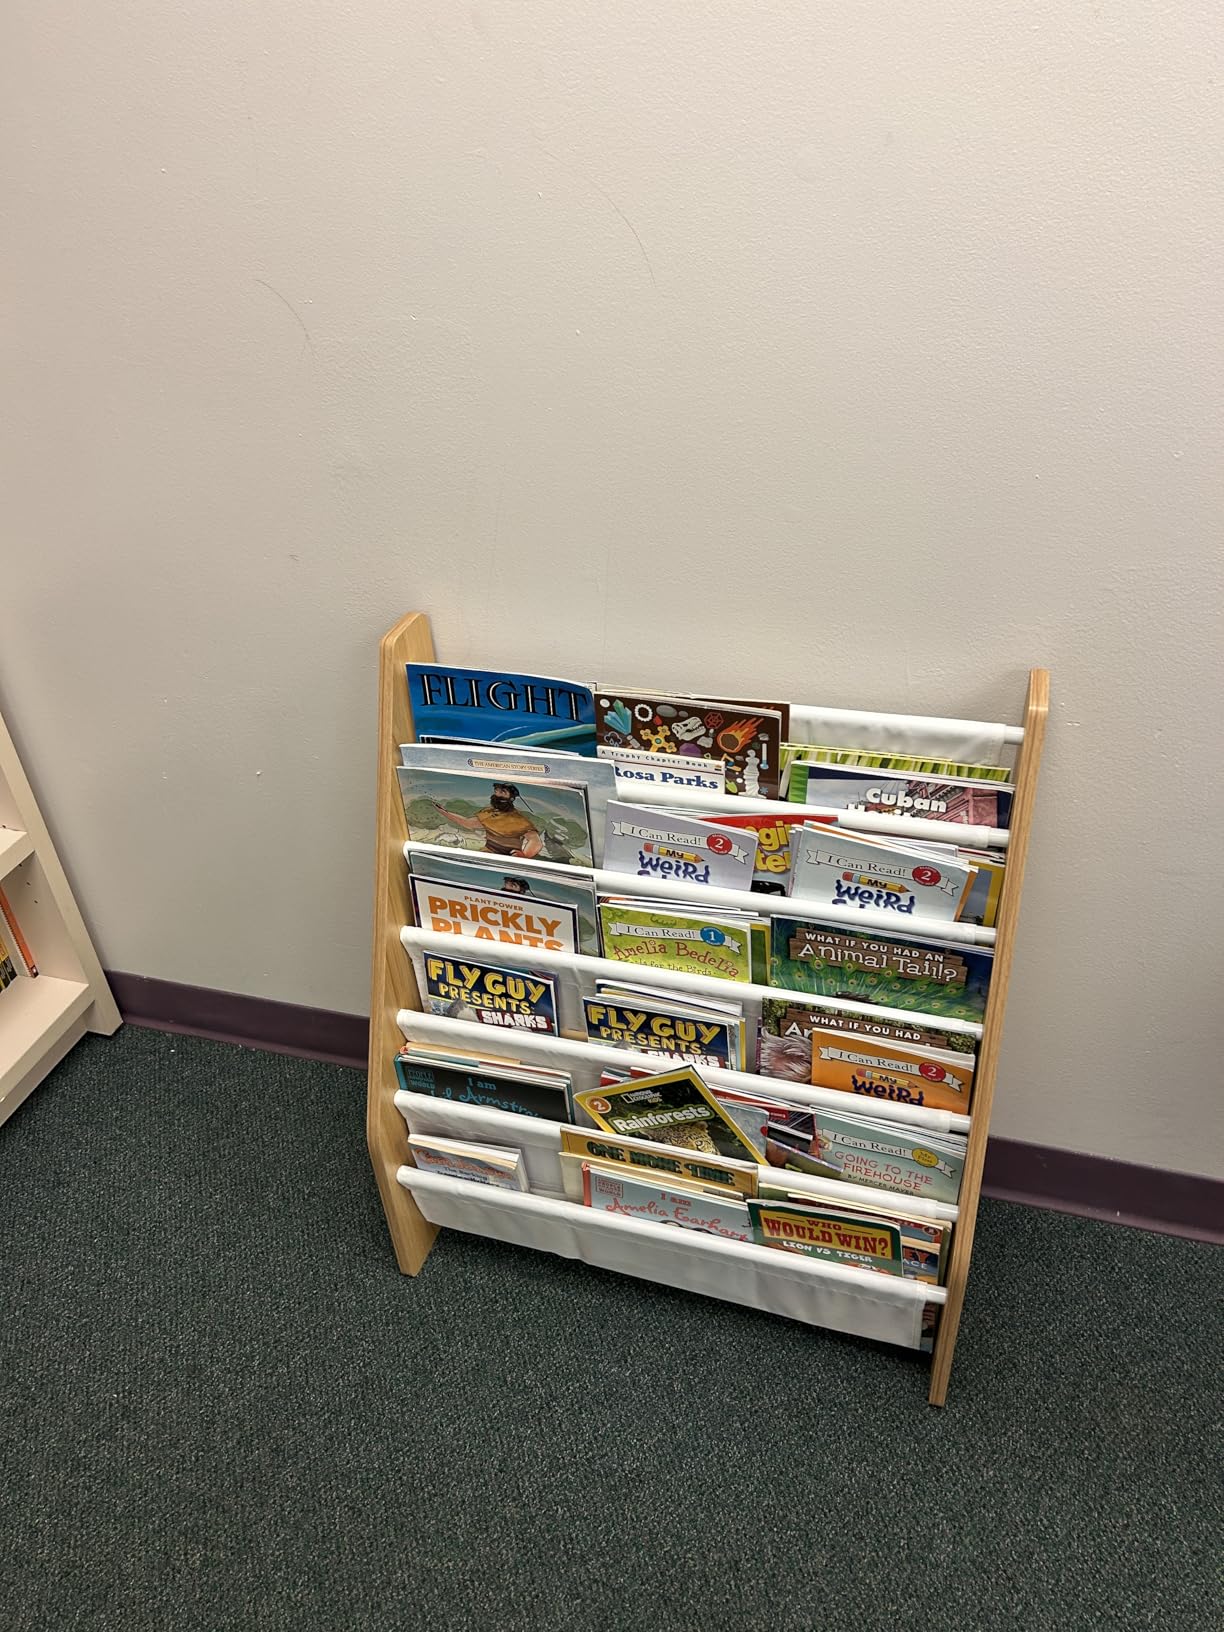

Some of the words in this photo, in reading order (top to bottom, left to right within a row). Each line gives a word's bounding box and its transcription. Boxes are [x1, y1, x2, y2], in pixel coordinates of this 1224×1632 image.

[417, 673, 589, 723] FLIGHT
[611, 751, 640, 760] Trophy
[645, 755, 681, 765] Chapter
[660, 771, 719, 789] Parks
[866, 787, 947, 813] Cuban
[636, 828, 663, 841] Can
[666, 832, 701, 846] Read!
[715, 838, 724, 848] 2
[666, 849, 684, 859] My
[836, 857, 864, 870] Can
[867, 861, 906, 877] Read!
[921, 870, 932, 880] 2
[867, 878, 888, 889] My
[464, 895, 492, 906] PLANT
[493, 901, 525, 912] POWER
[427, 895, 562, 938] PRICKLY
[634, 927, 659, 937] Can
[662, 929, 696, 939] Read!
[709, 931, 716, 941] 1
[613, 939, 667, 961] Amelia
[798, 943, 887, 969] Animal
[805, 932, 840, 945] WHAT
[845, 939, 856, 947] IF
[861, 941, 888, 953] YOU
[893, 946, 920, 958] HAD
[925, 953, 944, 962] AN
[675, 941, 740, 978] Bedelia
[668, 963, 683, 972] the
[686, 964, 712, 976] Birds
[427, 958, 481, 989] FLY
[483, 972, 546, 1004] GUY
[481, 1010, 548, 1029] SHARKS
[587, 1004, 647, 1032] FLY
[651, 1017, 721, 1045] GUY
[809, 1015, 844, 1029] WHAT
[848, 1021, 860, 1030] IF
[864, 1023, 890, 1036] YOU
[895, 1029, 921, 1041] HAD
[846, 1053, 872, 1065] Can
[876, 1058, 913, 1072] Read!
[928, 1066, 937, 1076] 2
[468, 1077, 473, 1087] I
[477, 1081, 496, 1091] am
[879, 1075, 897, 1085] My
[459, 1087, 540, 1117] Armstr
[593, 1101, 606, 1110] 2
[613, 1105, 711, 1132] Rainforests
[841, 1136, 866, 1148] Can
[871, 1141, 906, 1156] Read!
[587, 1141, 627, 1162] ONE
[629, 1151, 683, 1174] MORE
[684, 1163, 736, 1187] TIME
[835, 1151, 879, 1169] GOING
[885, 1163, 901, 1175] TO
[906, 1170, 933, 1185] THE
[843, 1163, 921, 1191] FIREHOUSE
[859, 1177, 887, 1188] MERCER
[889, 1185, 914, 1196] MAYER
[661, 1192, 666, 1201] I
[670, 1196, 692, 1207] am
[605, 1197, 669, 1217] Amelia
[673, 1208, 748, 1242] Earhart
[806, 1219, 843, 1231] WHO
[764, 1217, 833, 1243] WOULD
[835, 1231, 889, 1257] WIN?
[782, 1241, 813, 1252] LION
[836, 1251, 873, 1263] TIGER
